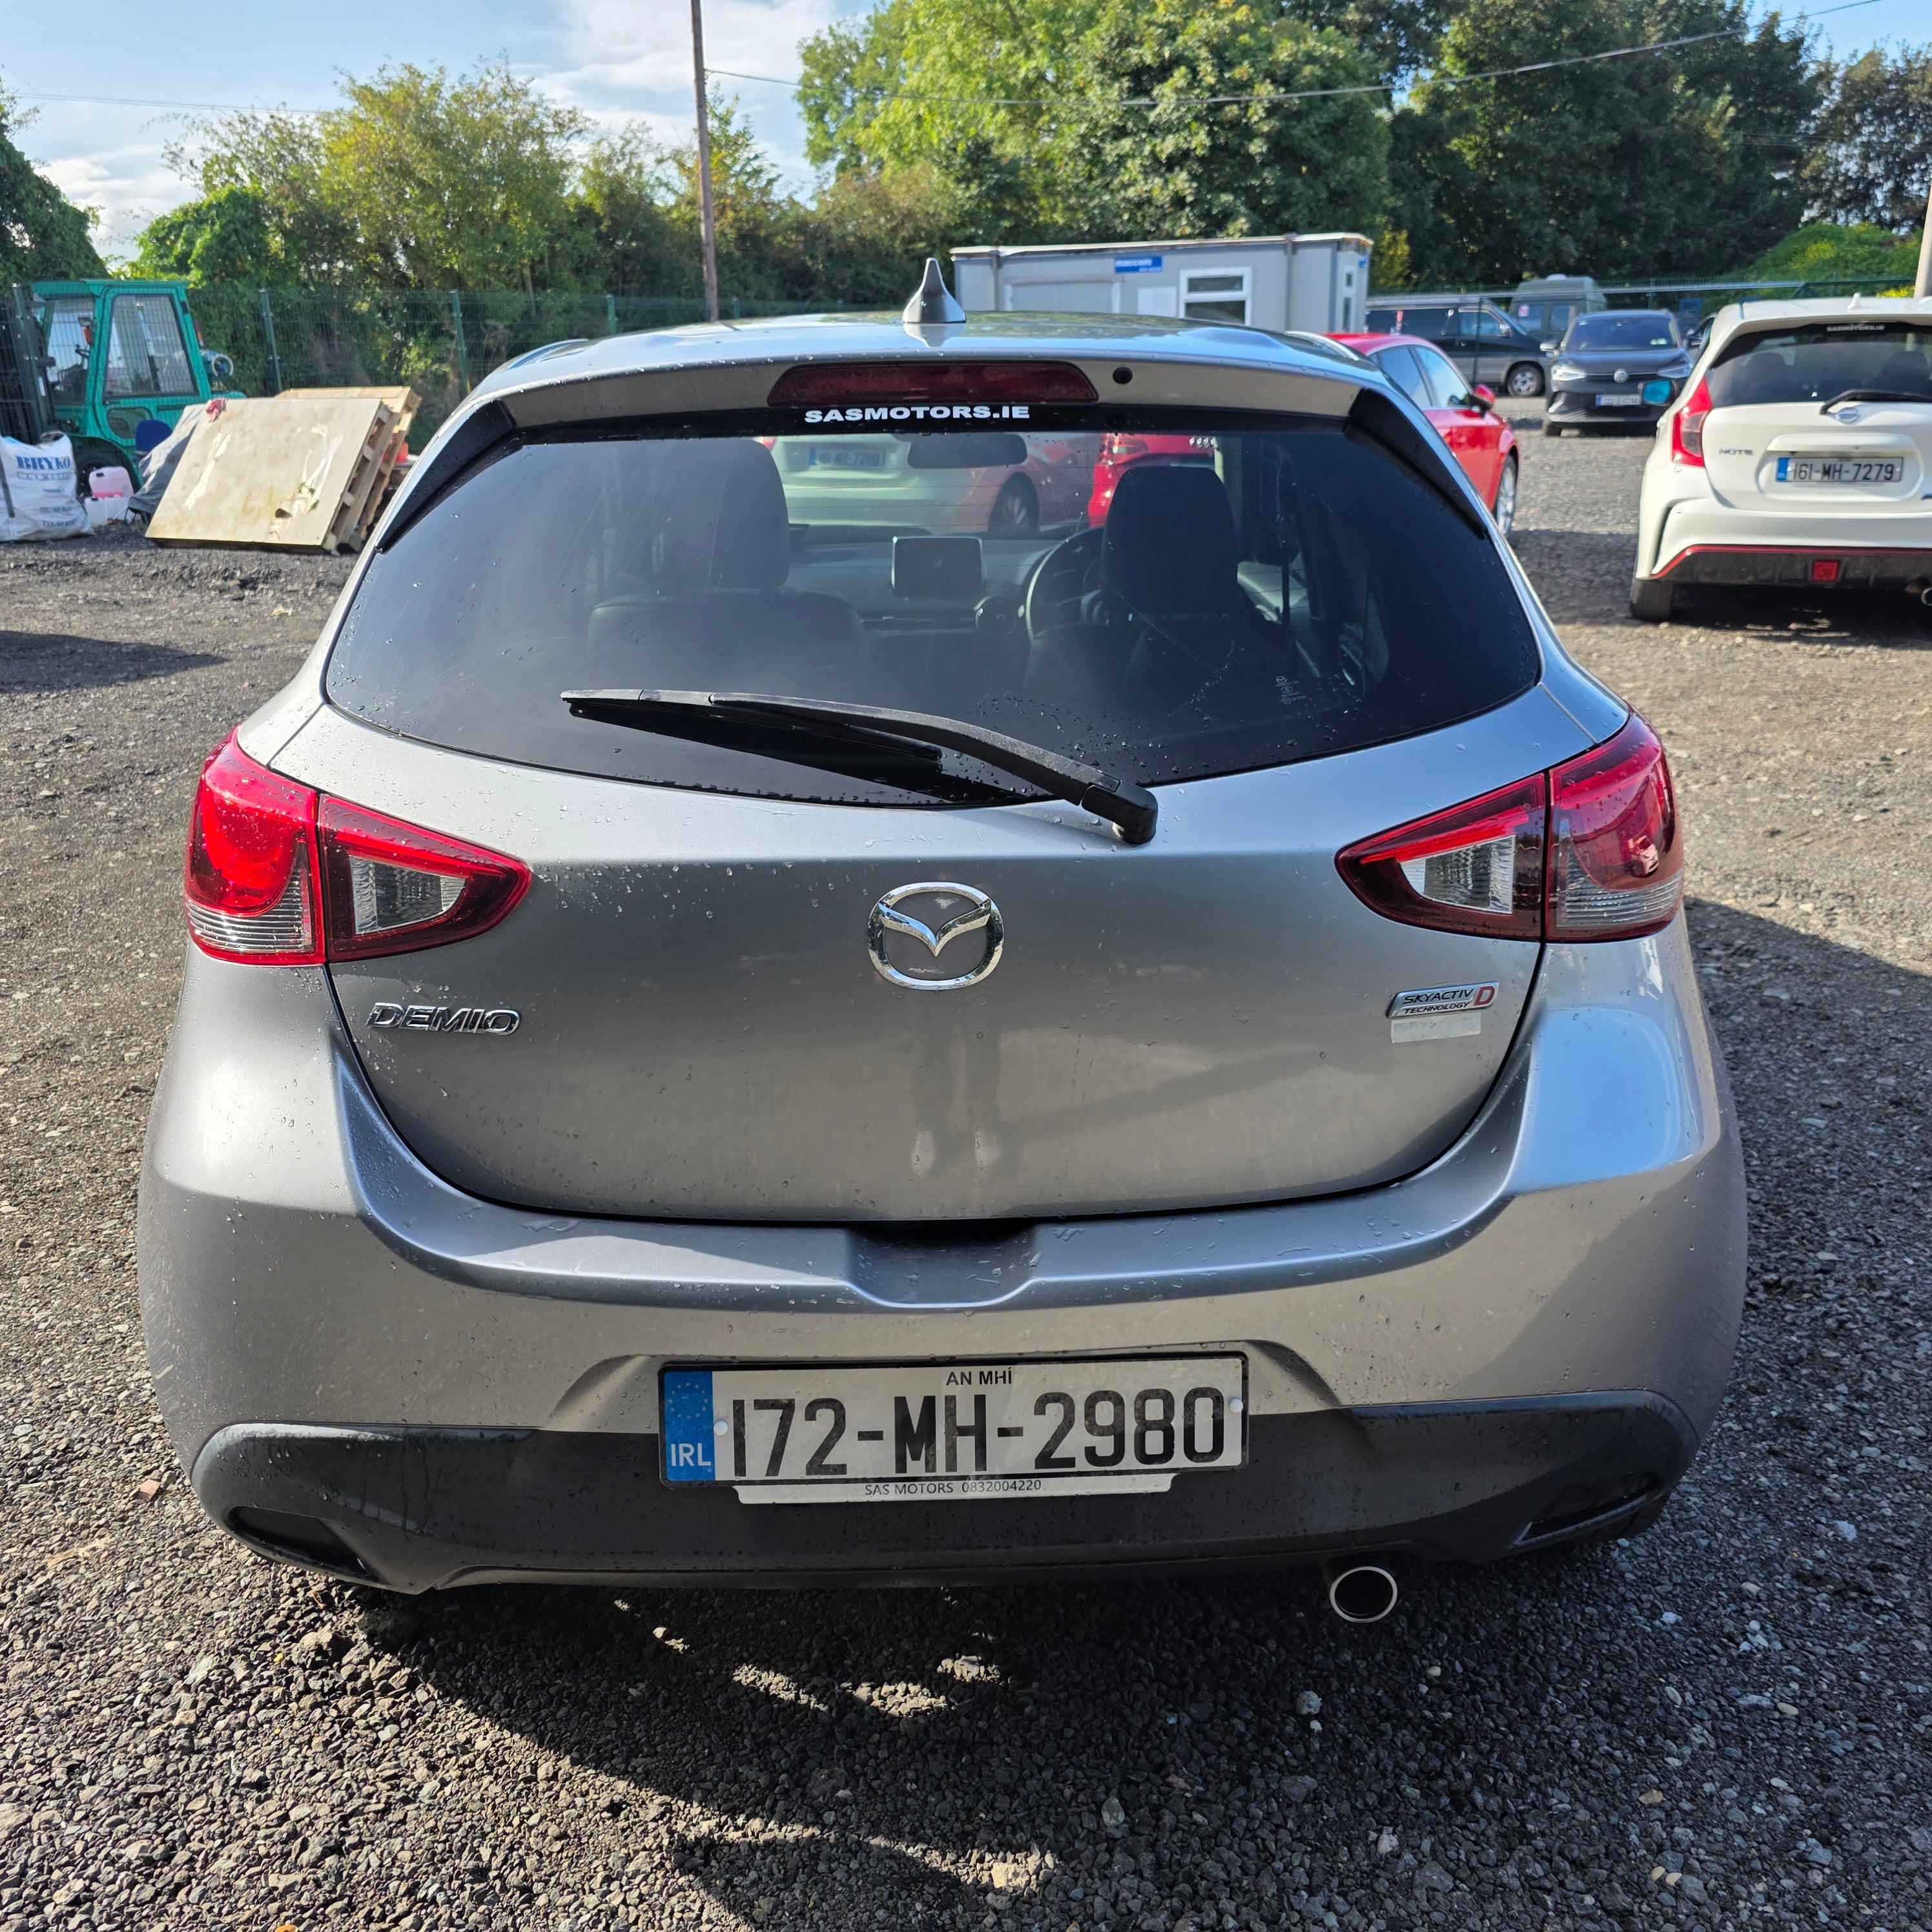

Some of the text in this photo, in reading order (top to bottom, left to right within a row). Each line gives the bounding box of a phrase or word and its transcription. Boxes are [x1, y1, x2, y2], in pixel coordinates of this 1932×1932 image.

[805, 406, 1030, 423] SASMOTORS.IE
[16, 456, 71, 470] BRYKO
[1793, 463, 1894, 481] 161-MH-7279
[1403, 985, 1495, 1006] SKYACTIV D
[1404, 1002, 1470, 1014] TECHNOLOGY
[365, 1002, 522, 1036] DEMIO
[946, 1366, 1012, 1386] AN MHÍ
[733, 1387, 1224, 1477] 172-MH-2980
[671, 1443, 712, 1466] IRL
[865, 1479, 1042, 1495] SAS MOTORS 0832004220
